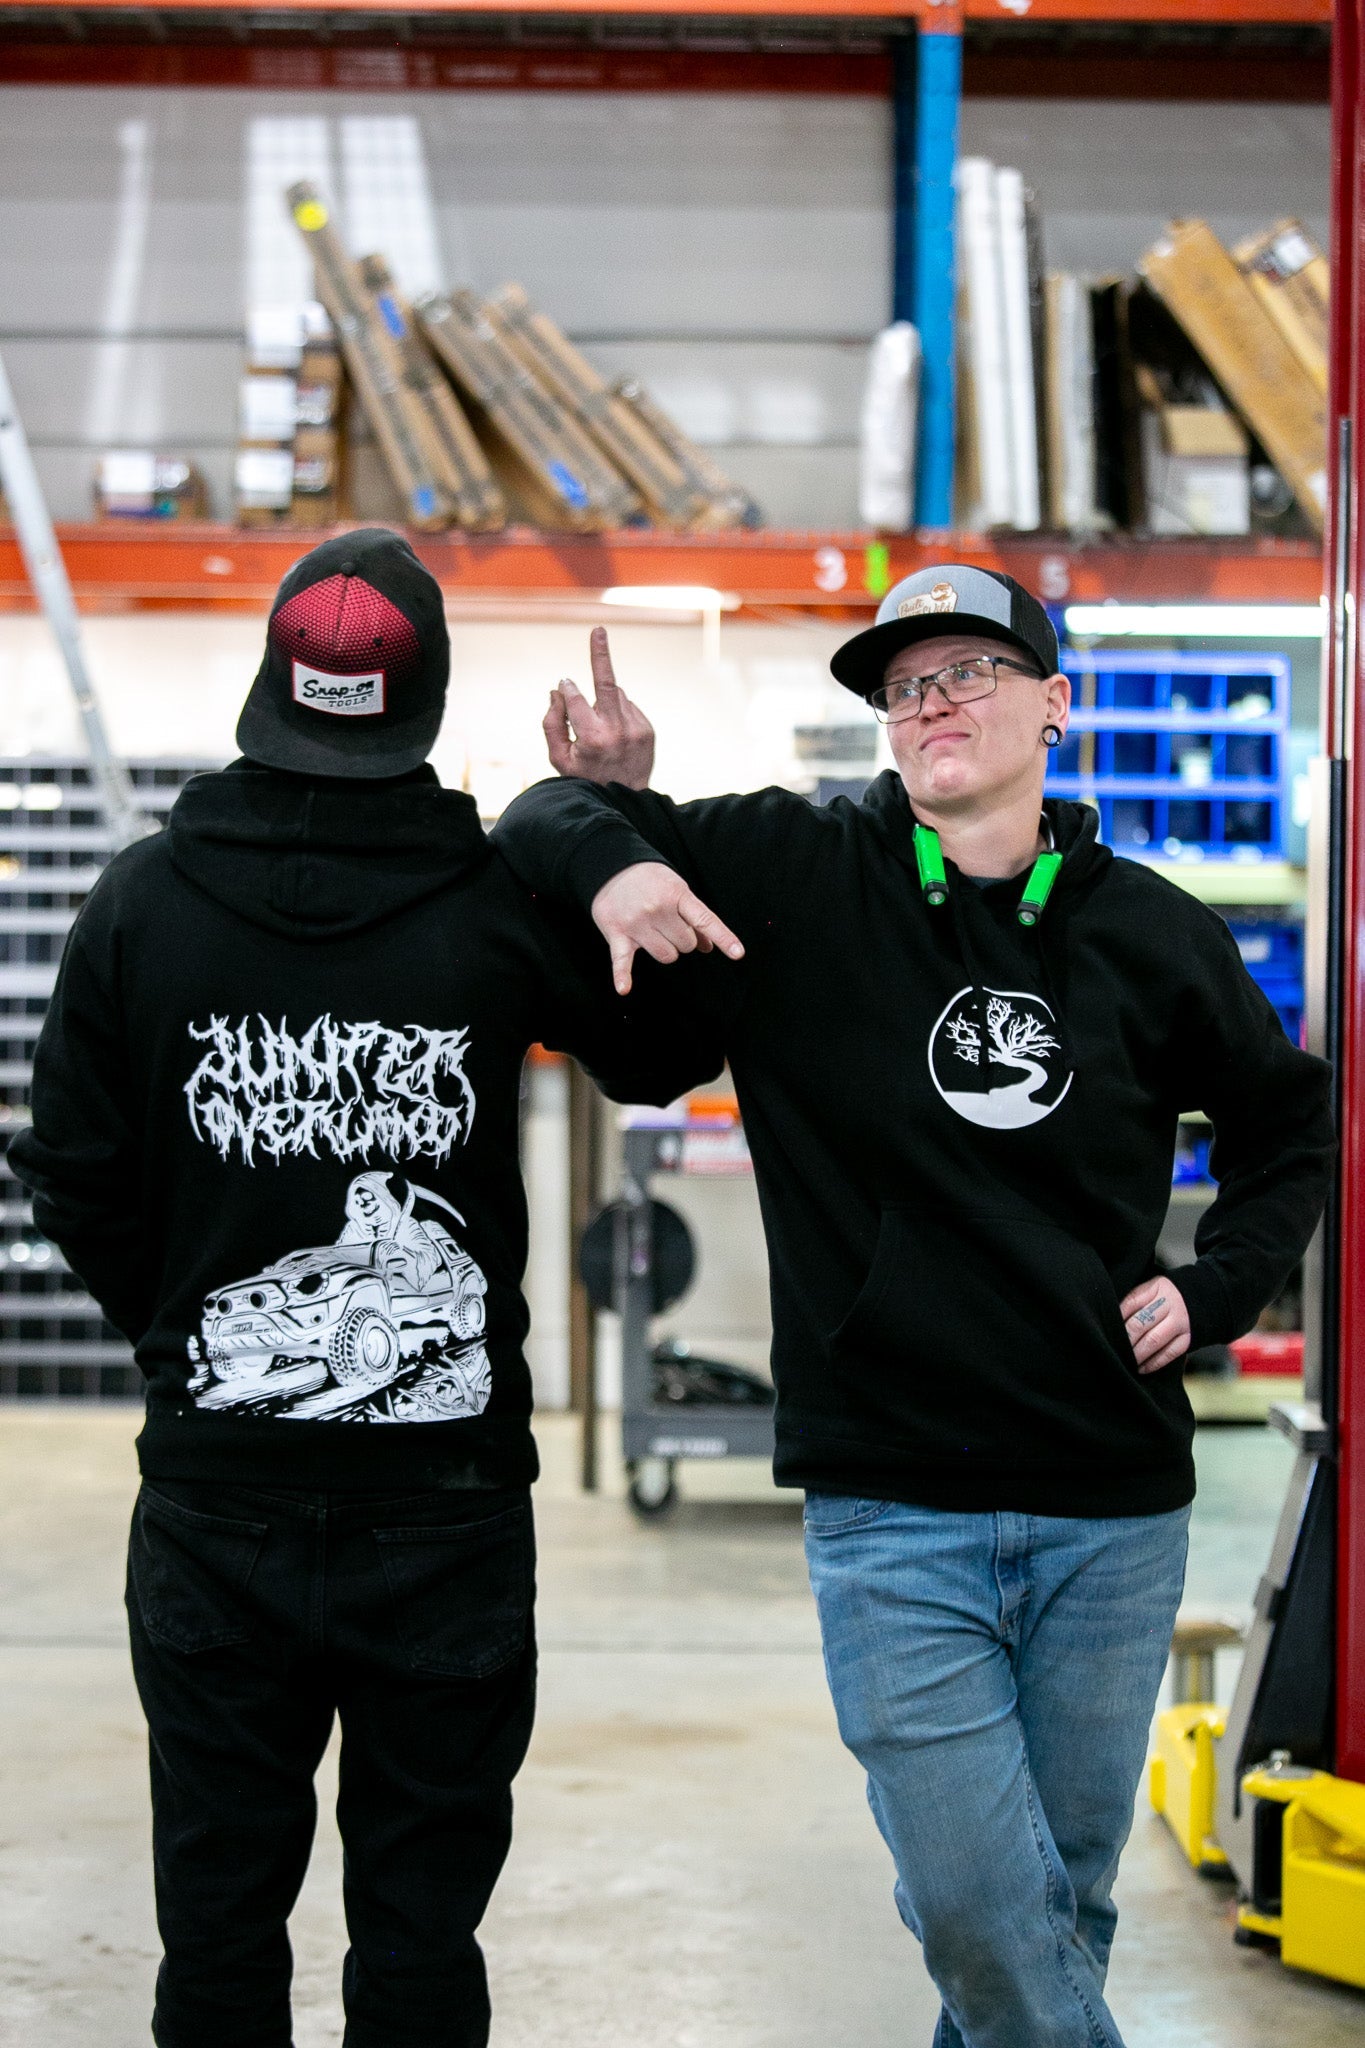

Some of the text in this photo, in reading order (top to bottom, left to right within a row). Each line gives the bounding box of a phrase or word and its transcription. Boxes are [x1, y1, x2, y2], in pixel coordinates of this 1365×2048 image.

[814, 547, 847, 592] 3
[302, 679, 375, 699] Snap-on
[328, 695, 368, 708] TOOLS
